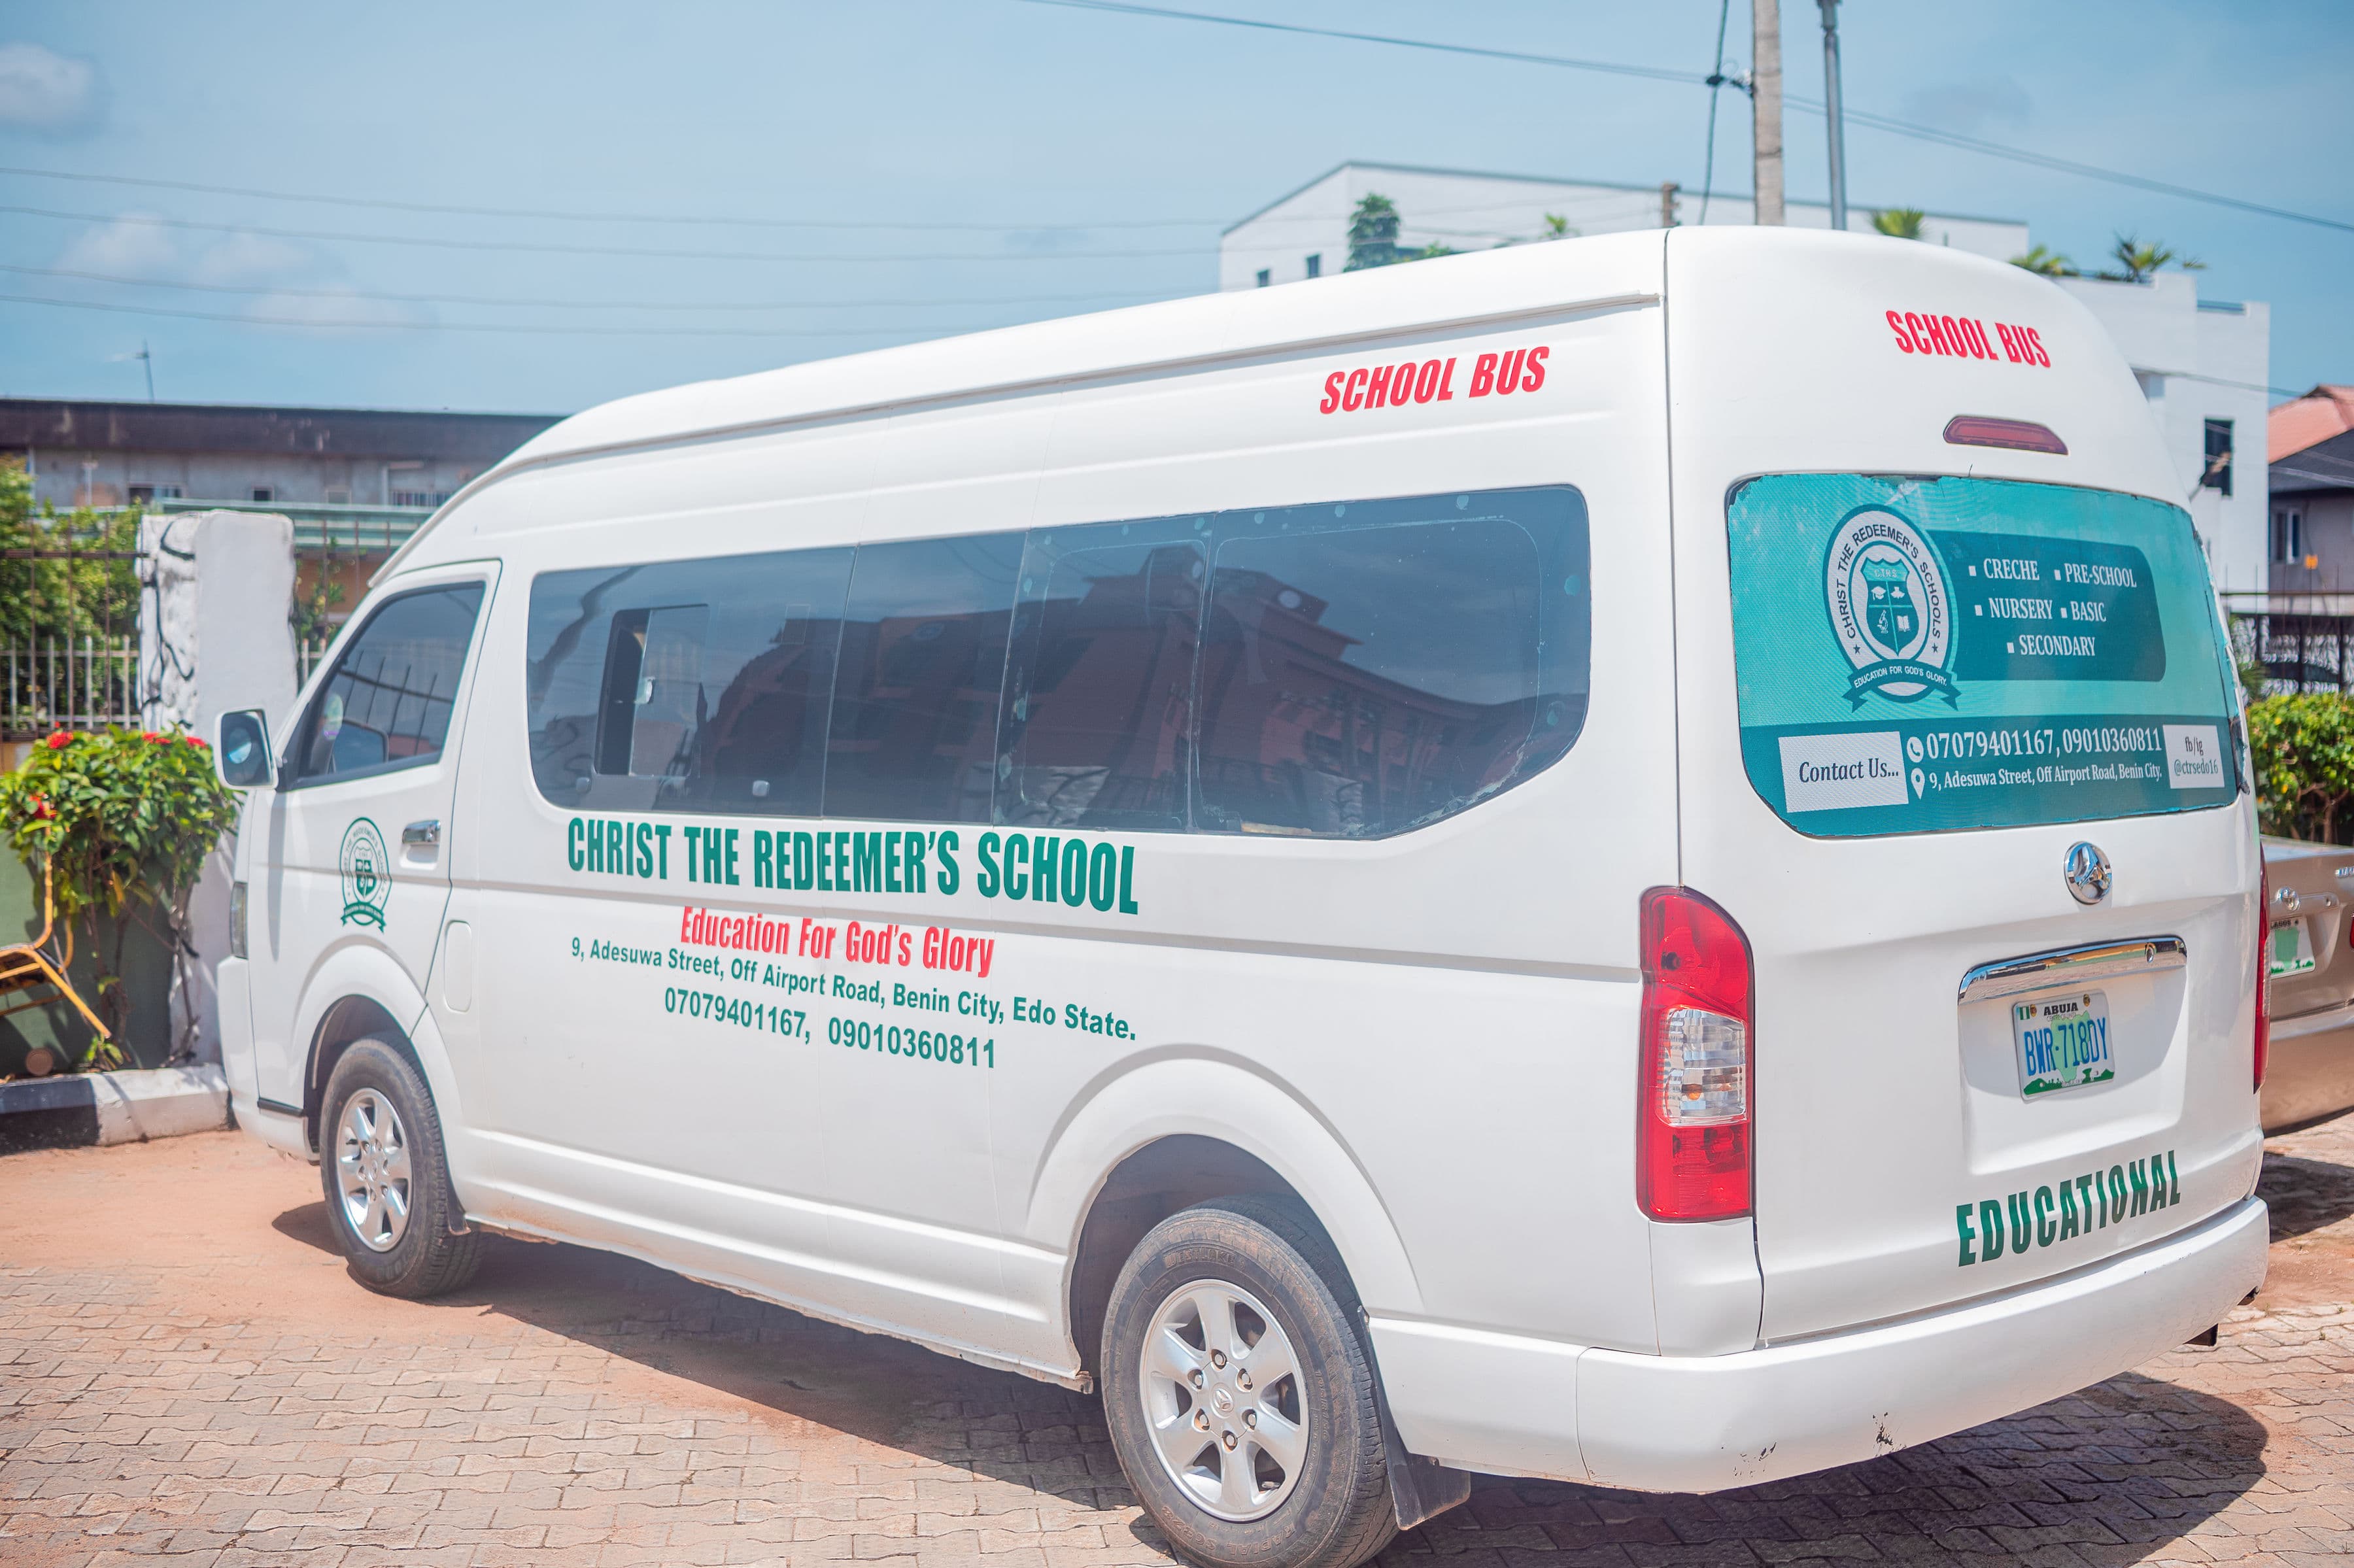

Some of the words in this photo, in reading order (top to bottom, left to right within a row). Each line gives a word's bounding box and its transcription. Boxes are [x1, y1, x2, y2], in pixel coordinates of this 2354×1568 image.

[1886, 310, 2000, 360] SCHOOL
[1994, 322, 2051, 368] BUS
[1320, 357, 1457, 415] SCHOOL
[1468, 346, 1550, 398] BUS
[1837, 543, 1854, 571] THE
[1852, 524, 1919, 559] REDEEMER'S
[1983, 558, 2040, 581] CRECHE
[2064, 563, 2137, 588] PRE-SCHOOL
[1836, 578, 1856, 639] CHRIST
[1920, 562, 1941, 639] SCHOOLS
[1988, 598, 2053, 619] NURSERY
[2070, 601, 2107, 622] BASIC
[2019, 634, 2095, 656] SECONDARY
[1853, 668, 1888, 688] EDUCATION
[1889, 666, 1903, 674] FOR
[1904, 666, 1924, 676] GOD'S
[1926, 672, 1947, 686] GLORY.
[1926, 730, 2060, 758] 07079401167,
[2062, 727, 2162, 754] 09010360811
[2185, 736, 2204, 755] fb/ig
[1799, 760, 1864, 783] Contact
[1868, 758, 1899, 777] Us...
[1929, 772, 1942, 792] 9,
[1944, 771, 1997, 789] Adesuwa
[1998, 768, 2036, 786] Street,
[2036, 766, 2052, 783] Off
[2054, 764, 2091, 786] Airport
[2091, 764, 2118, 782] Road,
[2119, 764, 2145, 779] Benin
[2146, 762, 2162, 779] City.
[2174, 759, 2219, 777] @ctrsedo16
[567, 817, 672, 880] CHRIST
[684, 826, 740, 885] THE
[753, 830, 960, 896] REDEEMER'S
[977, 831, 1139, 915] SCHOOL
[680, 906, 791, 955] Education
[798, 917, 837, 960] For
[845, 921, 913, 967] God's
[923, 925, 995, 979] Glory
[571, 937, 585, 961] 9,
[590, 938, 662, 967] Adesuwa
[668, 947, 725, 981] Street,
[730, 957, 758, 983] Off
[762, 964, 827, 995] Airport
[832, 974, 886, 1010] Road,
[893, 982, 950, 1013] Benin
[957, 991, 1004, 1025] City,
[1013, 996, 1057, 1025] Edo
[1064, 1003, 1136, 1041] State.
[2043, 1002, 2079, 1015] ABUJA
[664, 987, 811, 1045] 07079401167,
[828, 1016, 995, 1068] 09010360811
[1956, 1150, 2181, 1267] EDUCATIONAL
[1165, 1248, 1237, 1267] WESTLAKE
[1226, 1522, 1296, 1556] RADIAL
